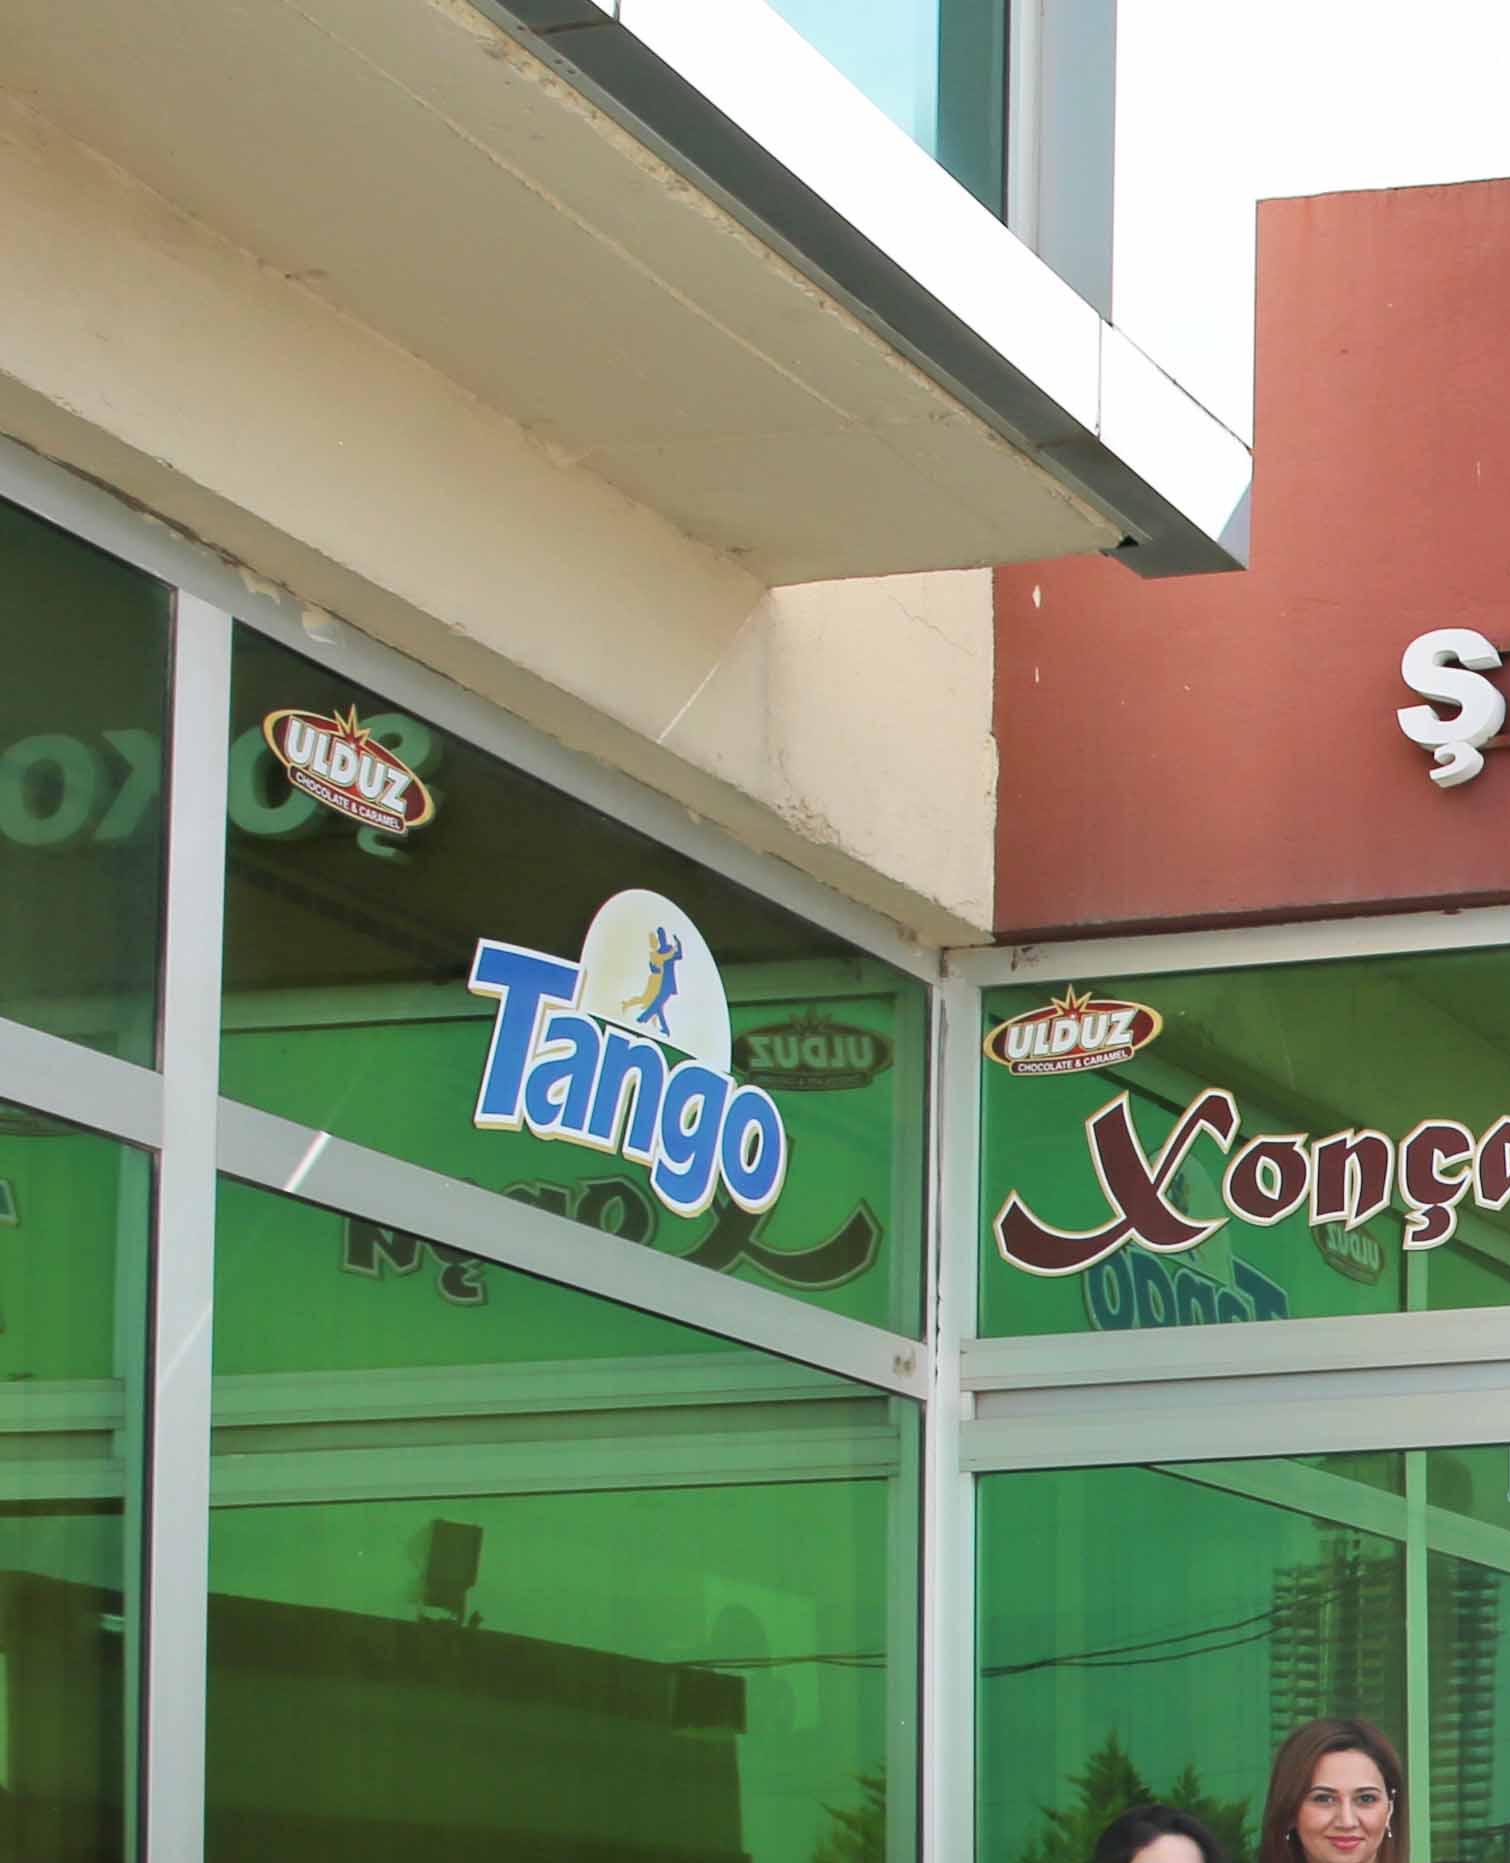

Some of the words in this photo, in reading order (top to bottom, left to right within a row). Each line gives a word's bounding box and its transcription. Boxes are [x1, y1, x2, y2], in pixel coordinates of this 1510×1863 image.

[285, 716, 411, 813] ULDUZ
[296, 772, 350, 809] CHOCOLATE
[358, 804, 402, 829] CARAMEL
[1007, 1008, 1138, 1059] ULDUZ
[1018, 1060, 1073, 1072] CHOCOLATE
[1083, 1049, 1129, 1067] CARAMEL
[469, 938, 788, 1218] Tango
